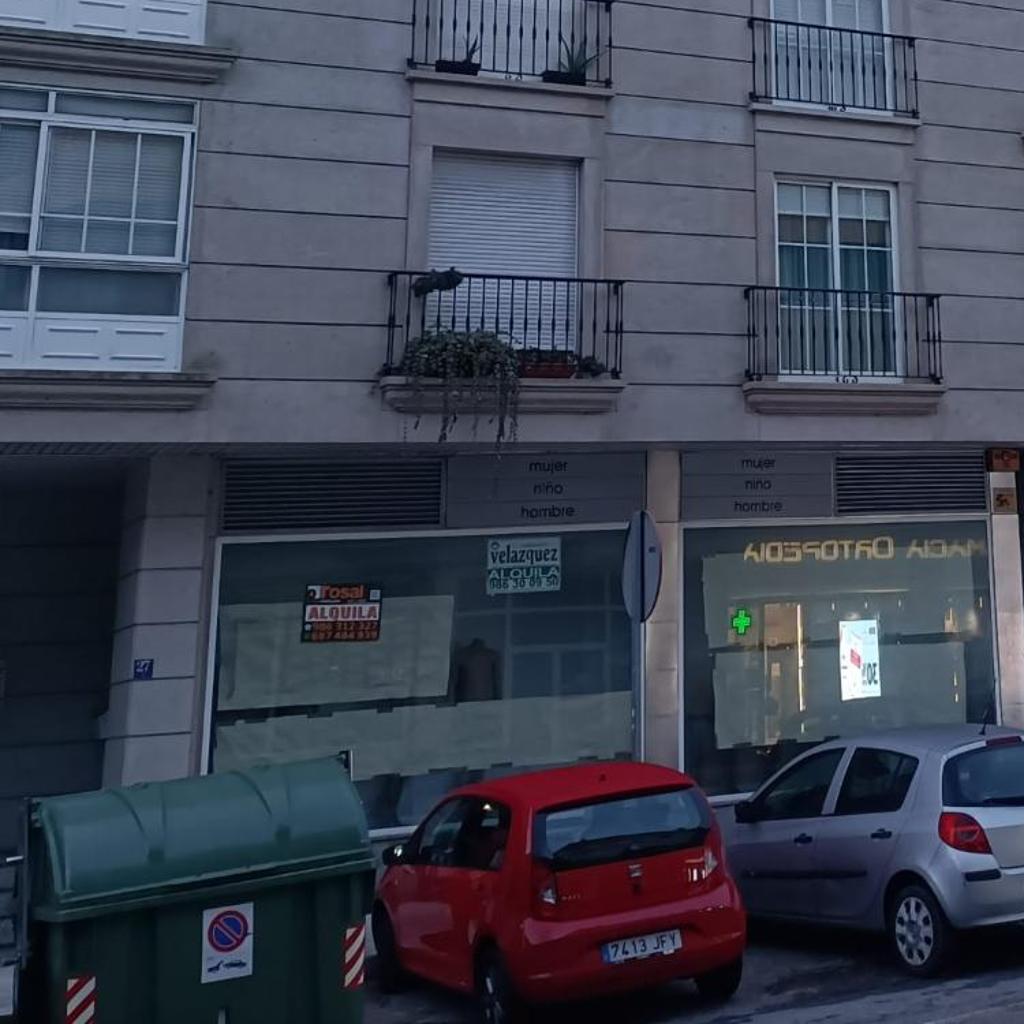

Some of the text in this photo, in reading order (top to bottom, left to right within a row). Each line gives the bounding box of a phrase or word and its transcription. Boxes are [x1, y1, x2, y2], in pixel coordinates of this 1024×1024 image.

[529, 461, 568, 474] mujer
[741, 458, 776, 471] mujer
[521, 505, 575, 518] hombre
[734, 500, 783, 512] hombre
[491, 545, 558, 564] velazquez
[489, 566, 559, 579] ALQUILA
[308, 606, 377, 619] ALQUILA
[611, 932, 676, 958] 7413 JFY
